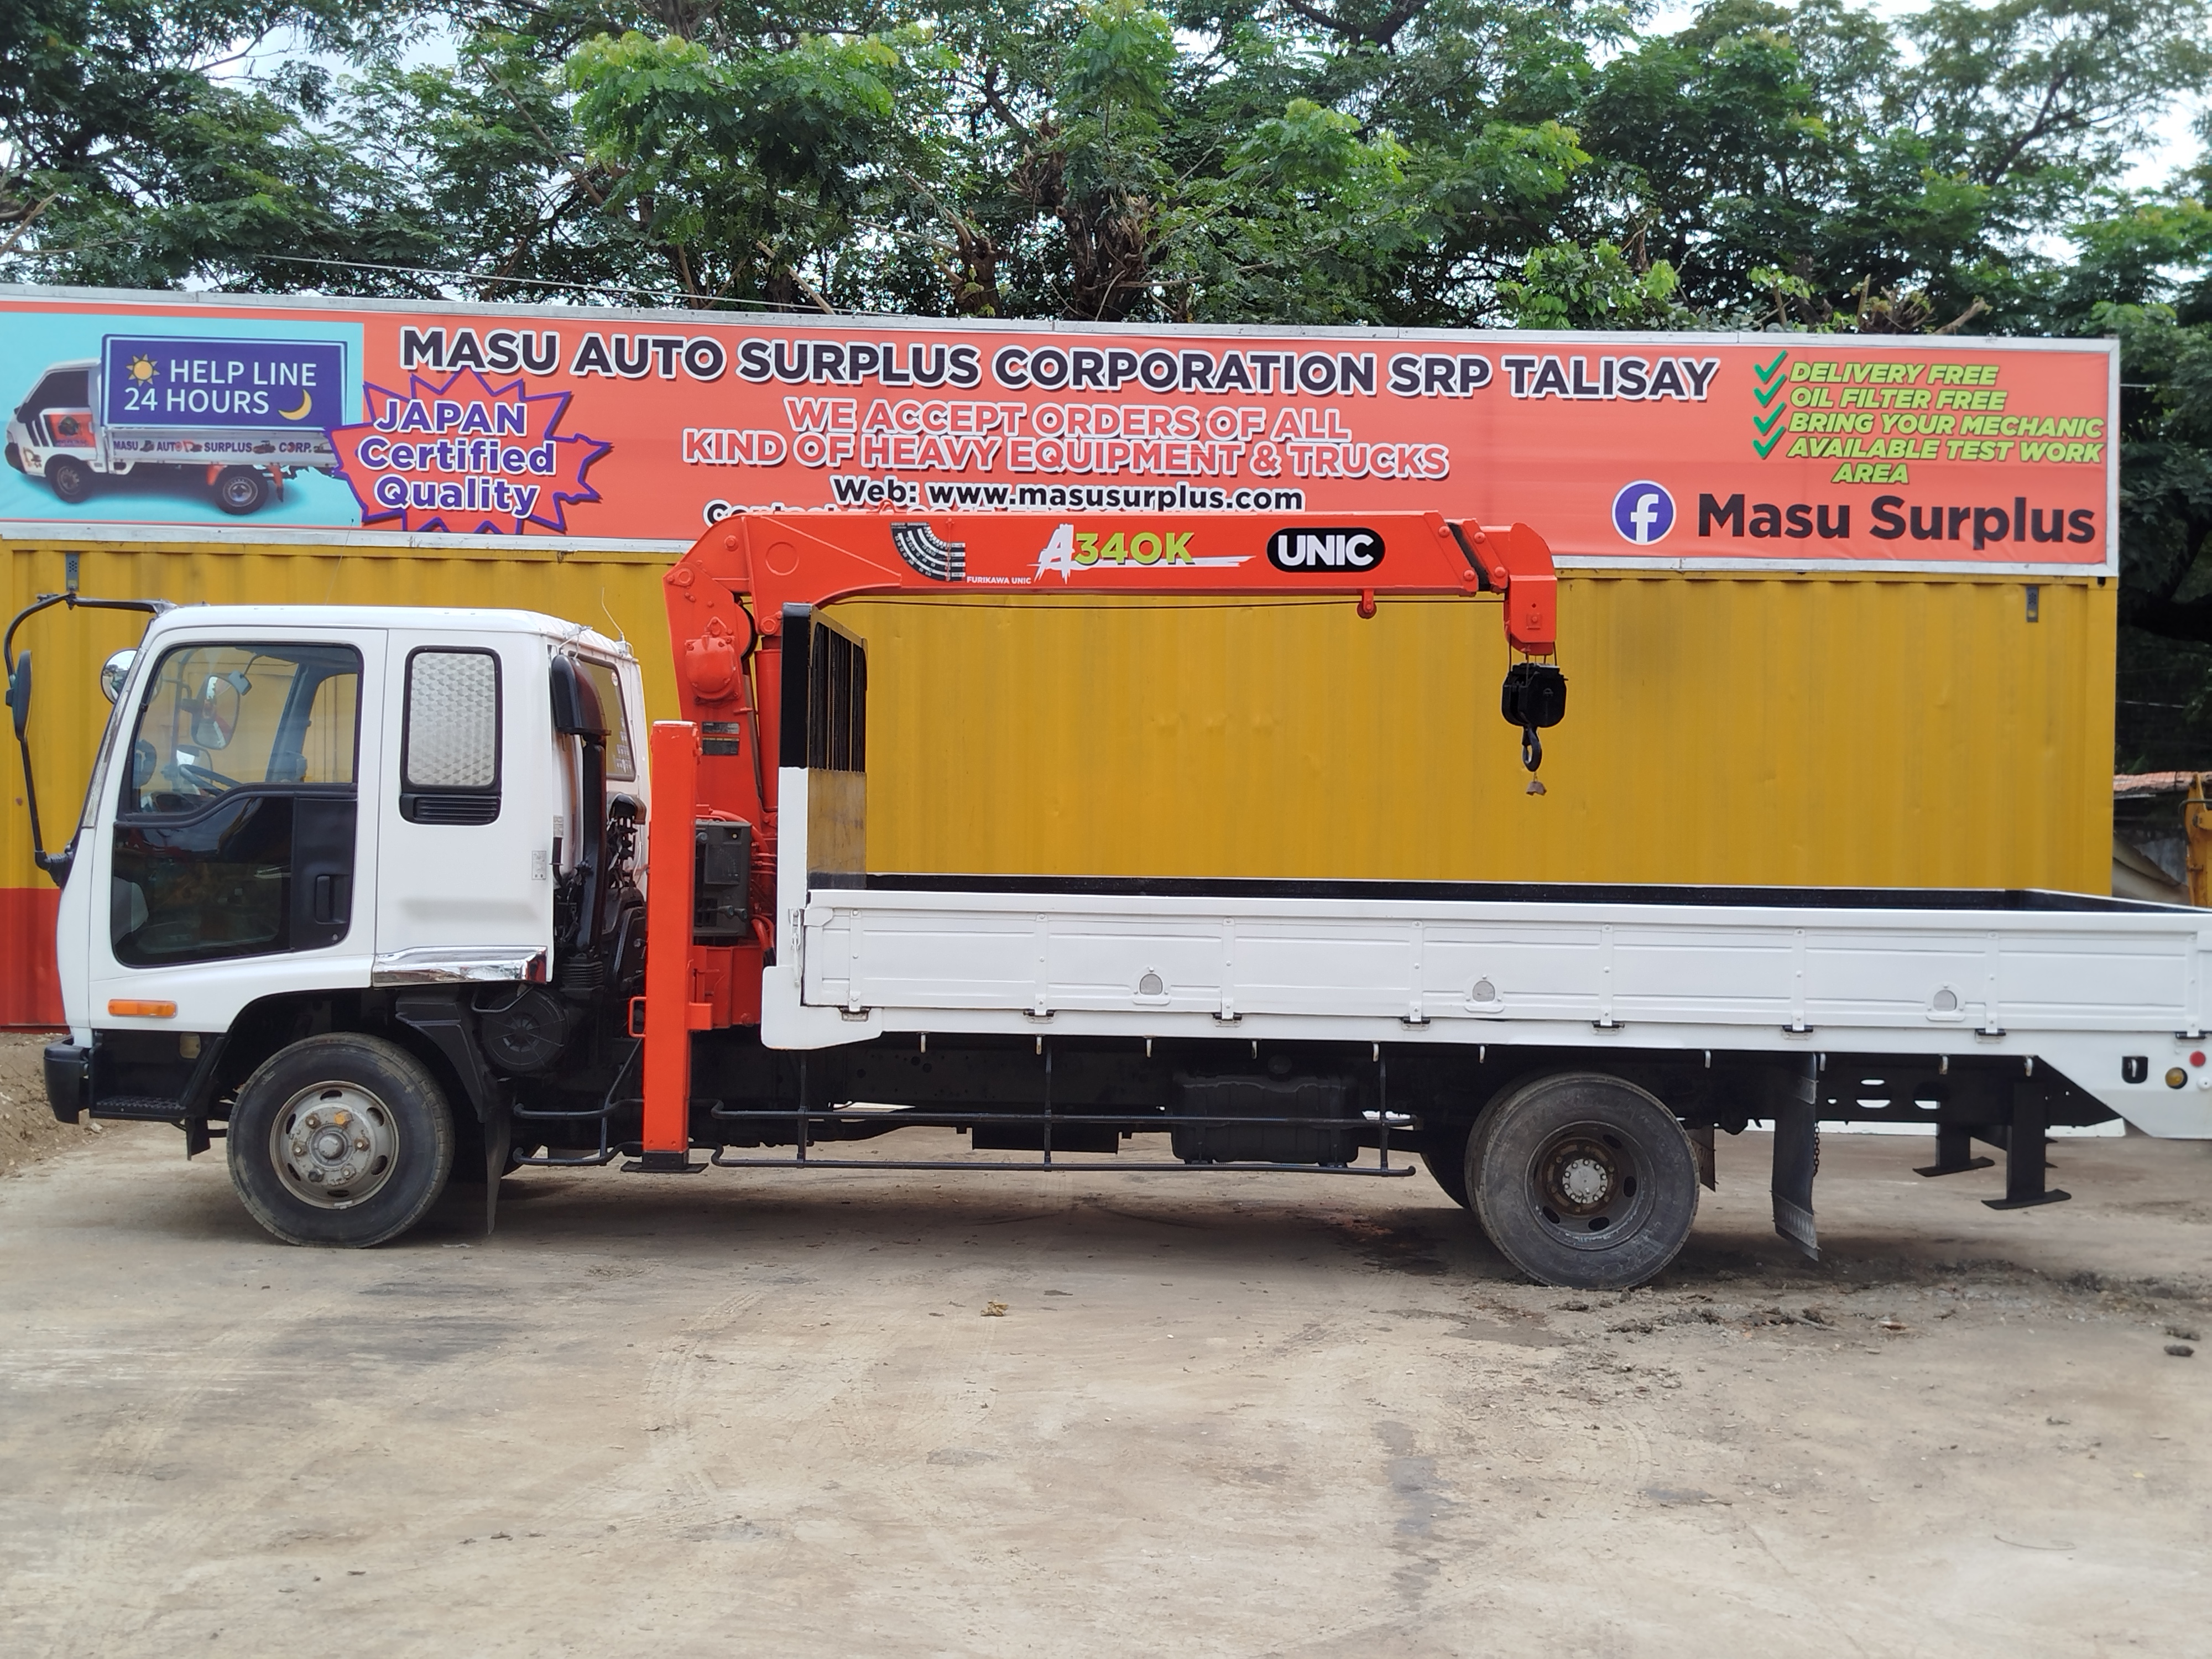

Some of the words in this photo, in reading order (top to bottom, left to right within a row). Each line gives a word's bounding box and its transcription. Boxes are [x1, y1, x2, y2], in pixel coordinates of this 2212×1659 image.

[170, 359, 244, 385] HELP
[253, 362, 317, 387] LINE
[400, 326, 560, 375] MASU
[570, 332, 726, 381] AUTO
[736, 337, 980, 387] SURPLUS
[991, 343, 1377, 395] CORPORATION
[1387, 352, 1493, 397] SRP
[1500, 354, 1720, 400] TALISAY
[1790, 362, 1925, 384] DELIVERY
[1926, 364, 1999, 387] FREE
[124, 388, 158, 411] 24
[166, 389, 269, 415] HOURS
[1790, 387, 1833, 408] OIL
[1838, 388, 1933, 410] FILTER
[1936, 390, 2008, 411] FREE
[374, 399, 527, 436] JAPAN
[784, 397, 857, 433] WE
[863, 399, 1027, 436] ACCEPT
[1032, 402, 1201, 440] ORDERS
[1205, 405, 1266, 441] OF
[1270, 407, 1352, 442] ALL
[1788, 412, 1873, 434] BRING
[1881, 413, 1955, 435] YOUR
[1959, 415, 2105, 439] MECHANIC
[113, 440, 139, 451] MASU
[204, 441, 253, 452] SURPLUS
[279, 442, 312, 453] CORP.
[357, 436, 556, 475] Certified
[682, 428, 787, 466] KIND
[793, 432, 854, 467] OF
[860, 434, 1001, 471] HEAVY
[1008, 436, 1245, 477] EQUIPMENT
[1249, 441, 1282, 476] &
[1286, 442, 1450, 479] TRUCKS
[1786, 436, 1940, 460] AVAILABLE
[1945, 440, 2014, 461] TEST
[2020, 441, 2105, 463] WORK
[1831, 463, 1909, 484] AREA
[374, 474, 540, 519] Quality
[830, 476, 920, 504] Web:
[925, 481, 1306, 513] www.masusurplus.com
[1698, 493, 1850, 538] Masu
[1869, 495, 2096, 550] Surplus
[1277, 534, 1374, 566] UNIC
